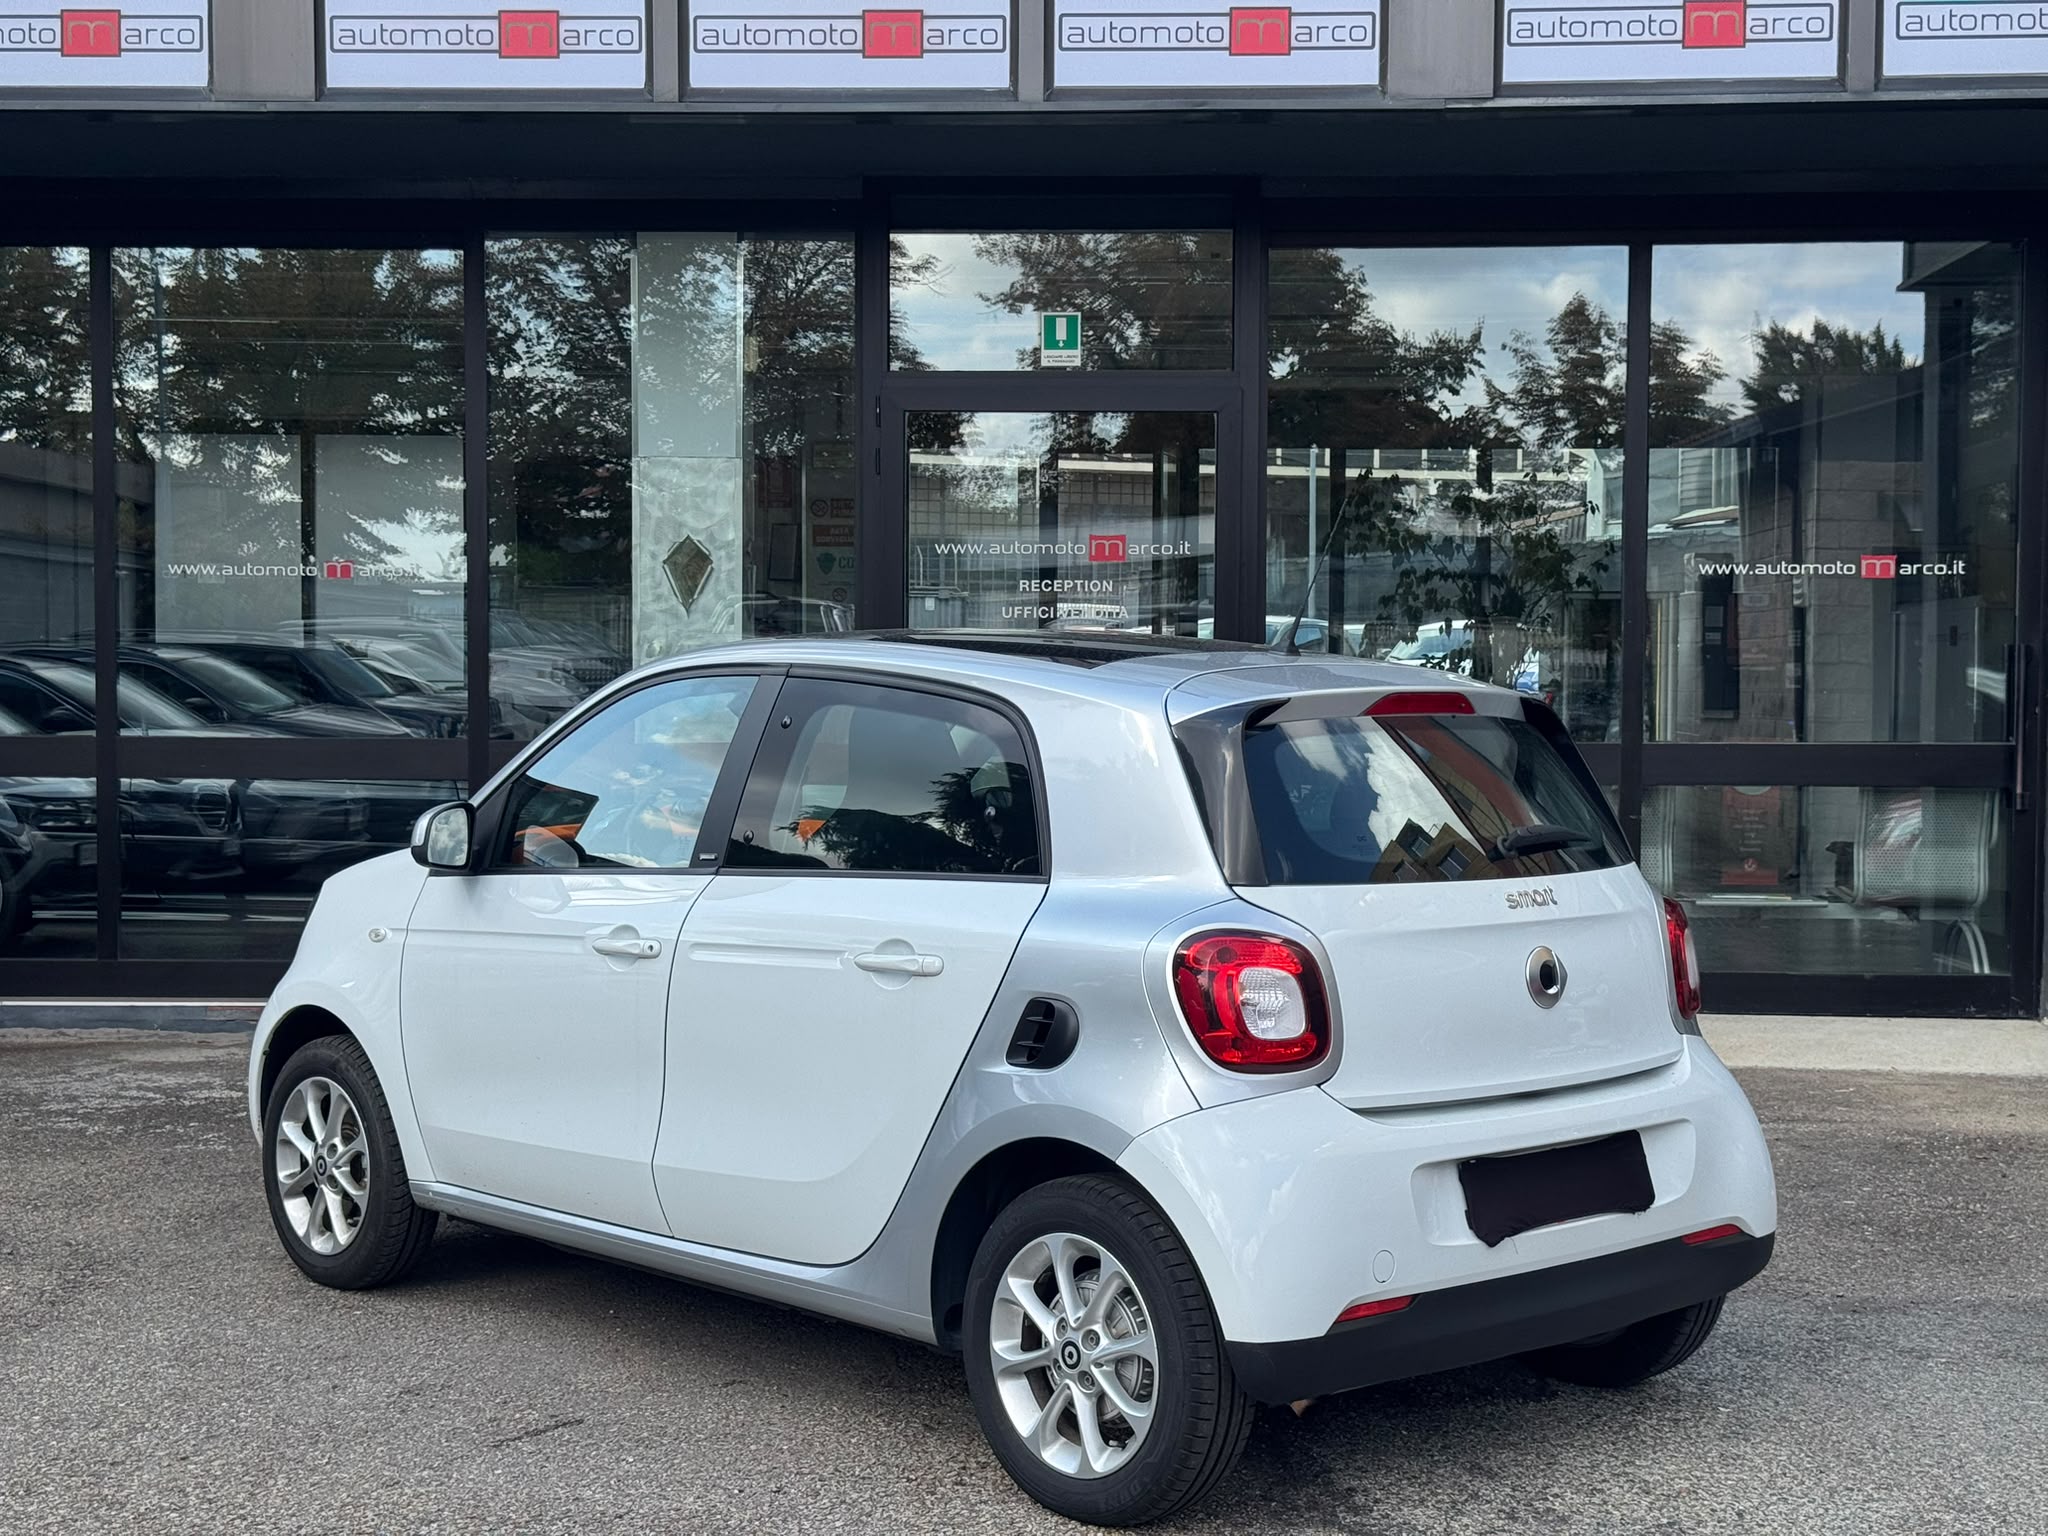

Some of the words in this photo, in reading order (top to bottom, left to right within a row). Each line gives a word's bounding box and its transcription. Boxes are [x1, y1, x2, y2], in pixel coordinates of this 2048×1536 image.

[0, 20, 196, 46] otomarco
[1019, 579, 1113, 592] RECEPTION
[1001, 606, 1054, 619] UFFICI
[1505, 885, 1558, 910] smart
